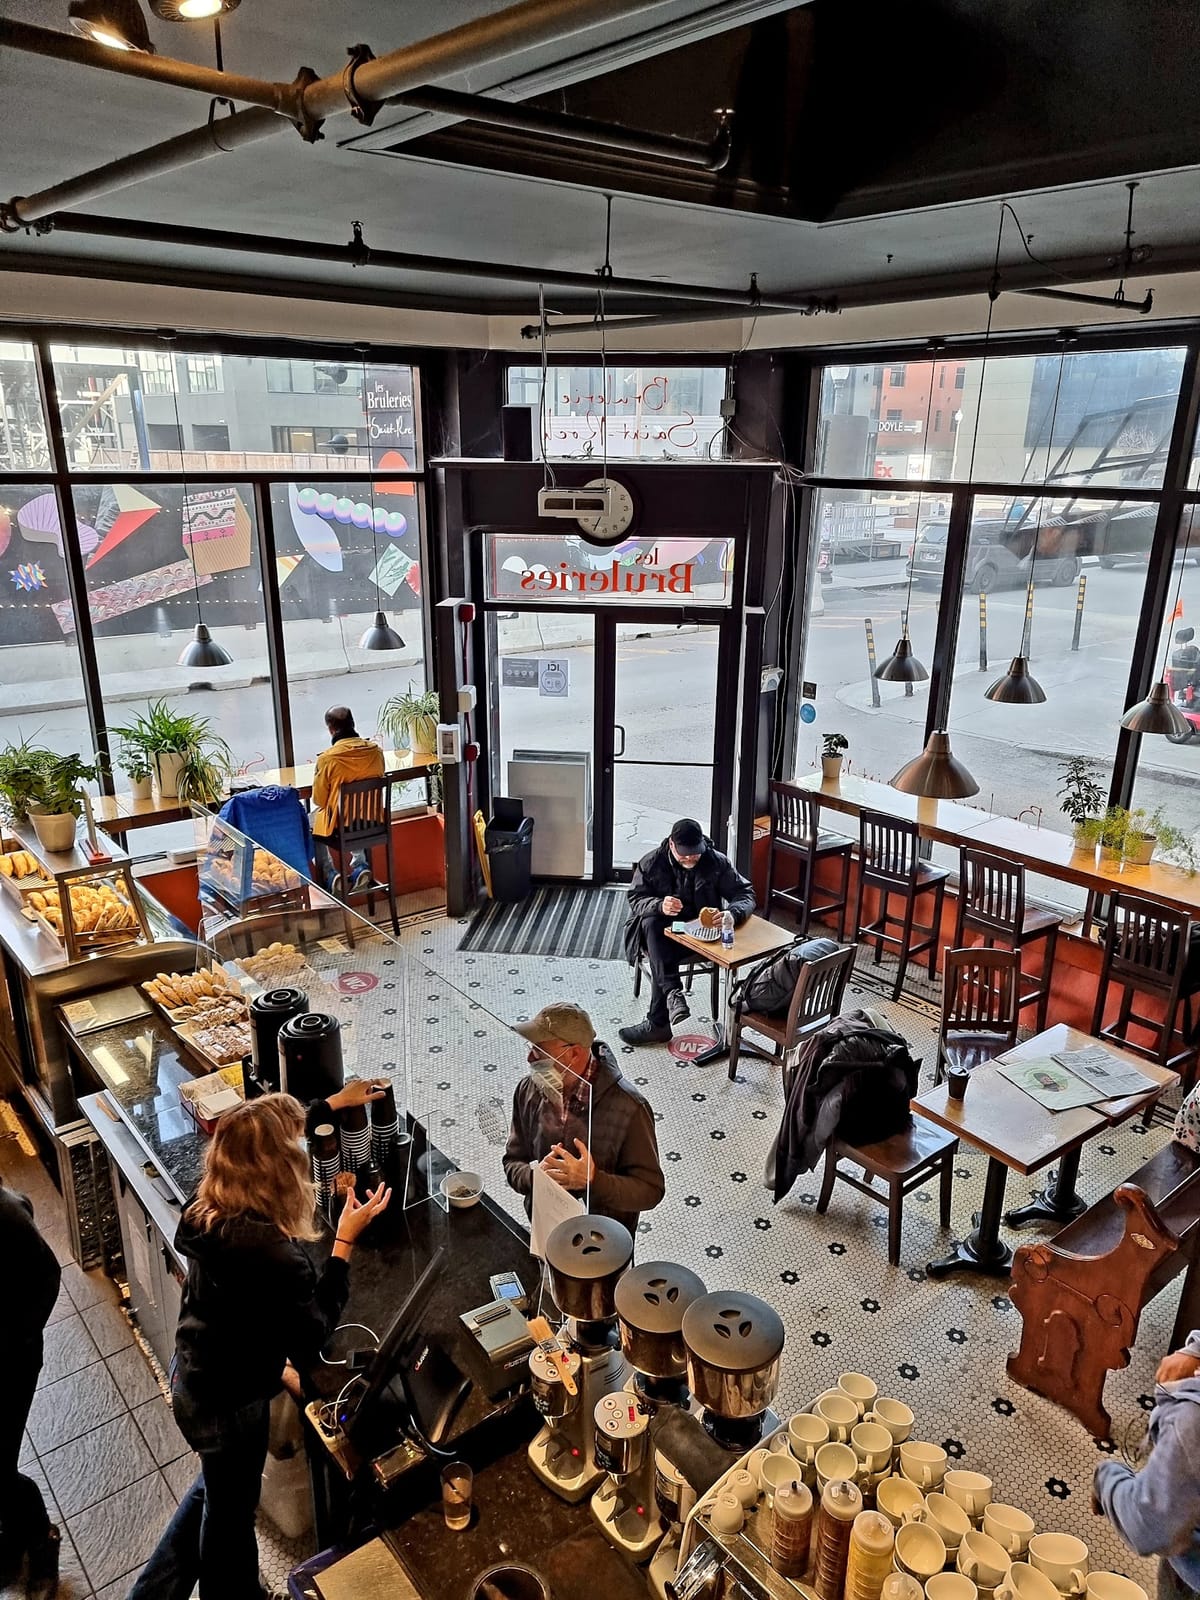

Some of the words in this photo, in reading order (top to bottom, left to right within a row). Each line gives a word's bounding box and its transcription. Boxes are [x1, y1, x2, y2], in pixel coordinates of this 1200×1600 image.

[374, 380, 384, 393] les
[367, 390, 412, 409] Bruleries
[878, 421, 904, 432] DOYLE
[679, 1041, 711, 1054] 2M
